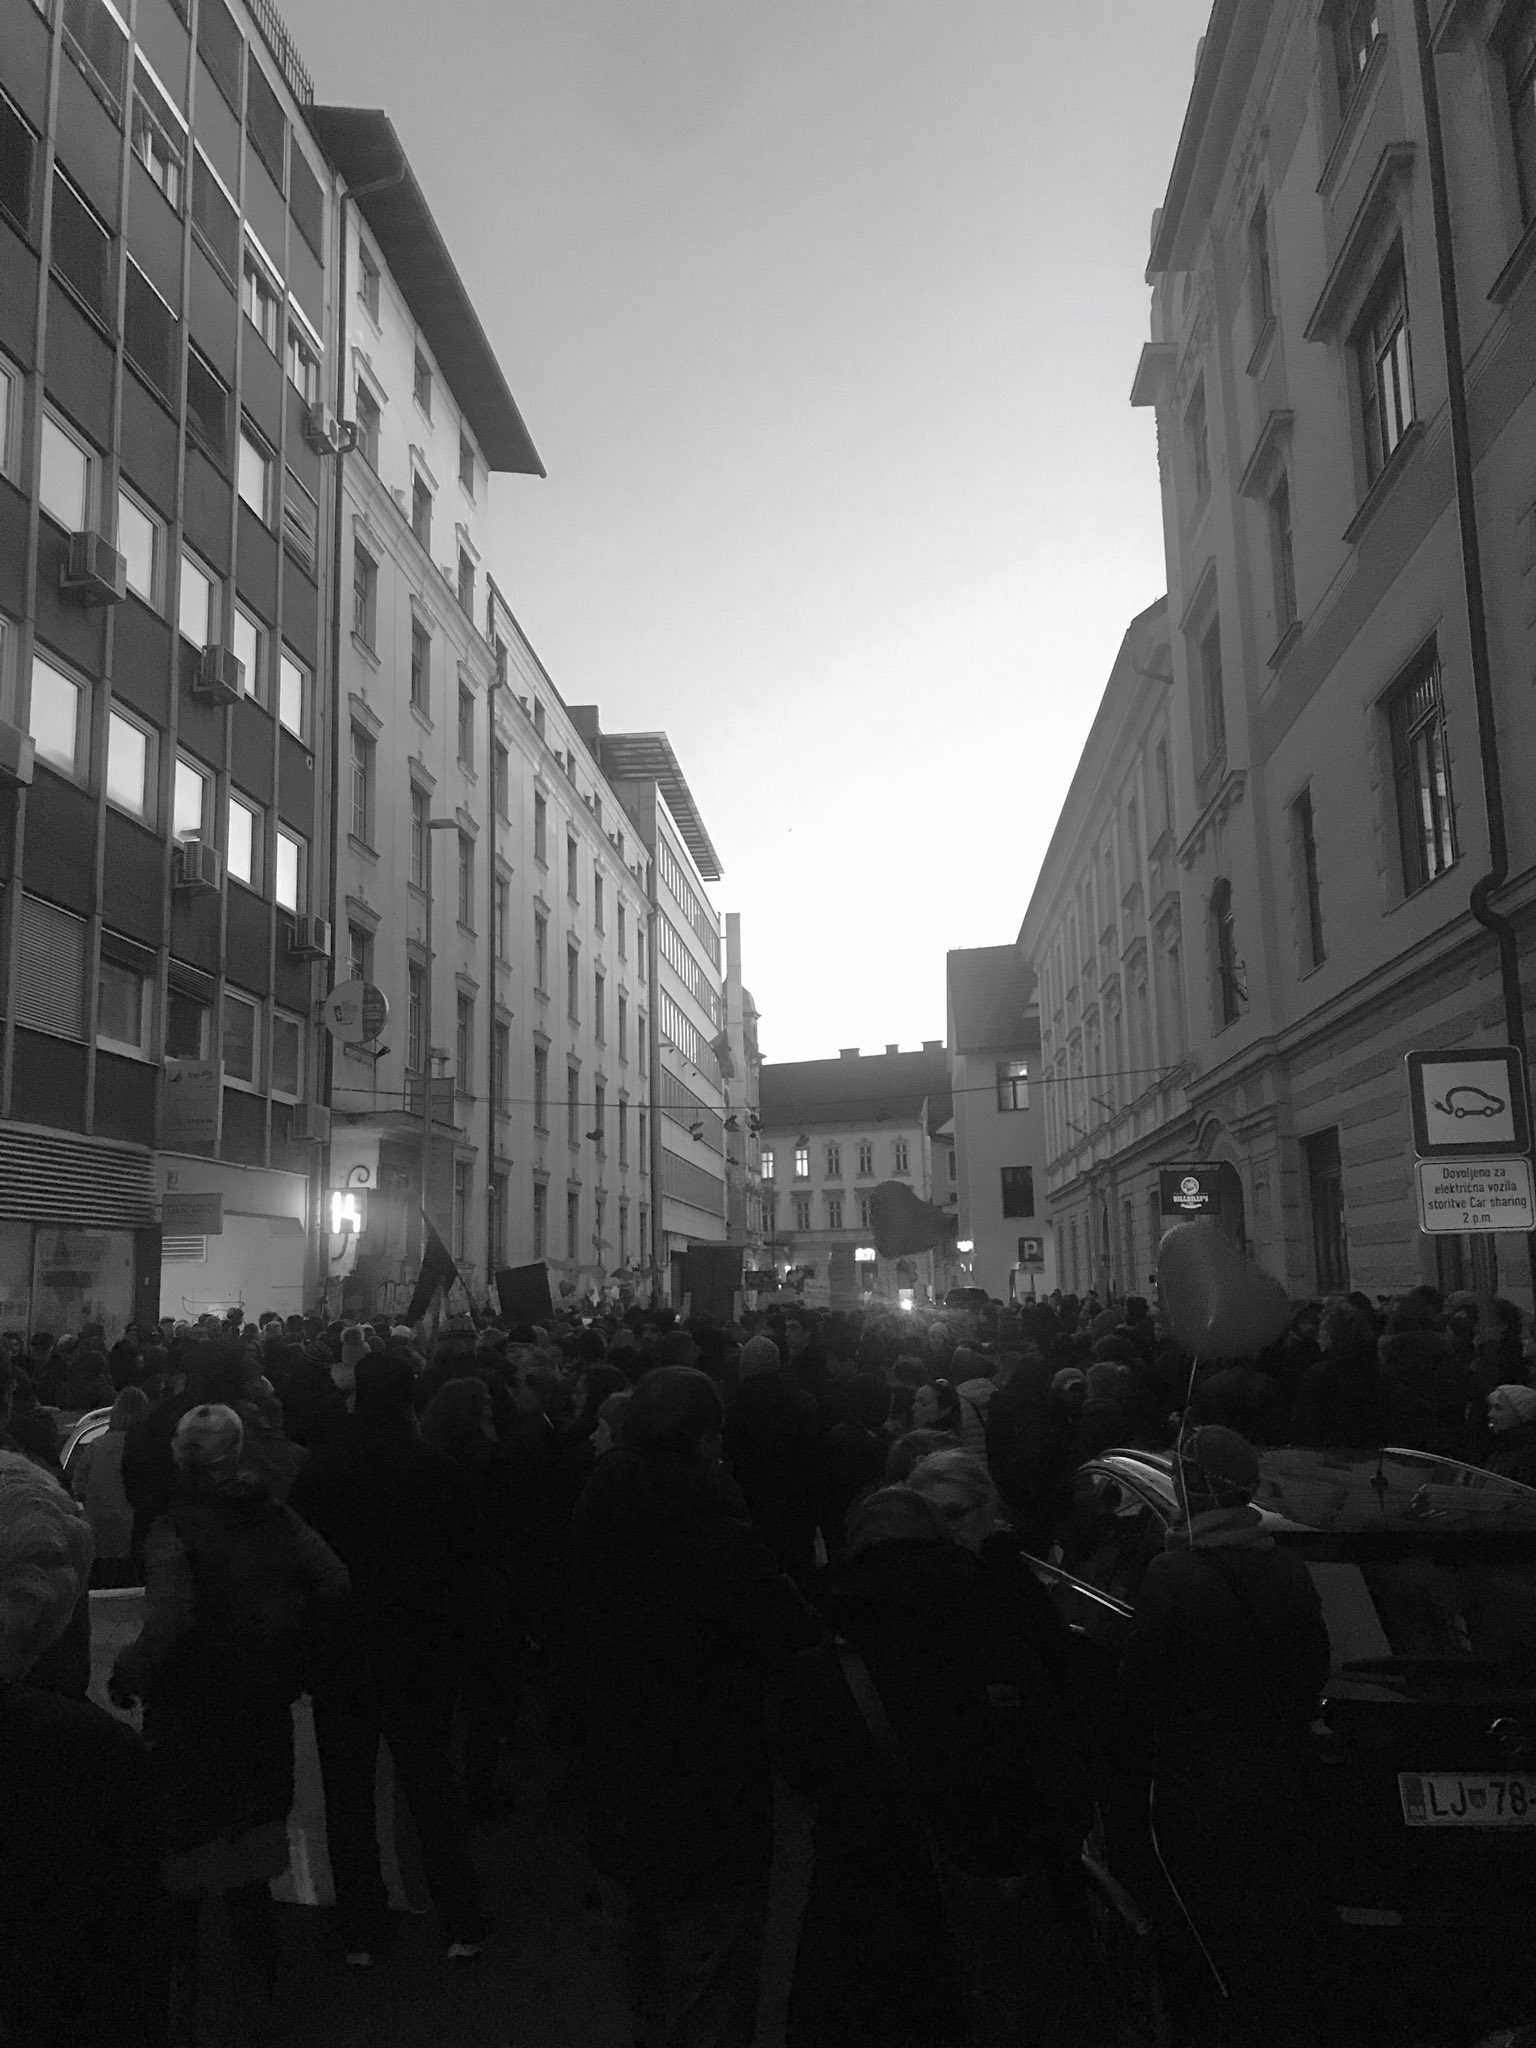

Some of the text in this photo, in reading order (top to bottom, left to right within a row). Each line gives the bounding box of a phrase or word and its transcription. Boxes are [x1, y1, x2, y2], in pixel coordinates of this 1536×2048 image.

[1443, 1168, 1506, 1180] Dovoljeno za
[1487, 1181, 1517, 1192] vozila
[1428, 1196, 1527, 1210] storitve Car sharing
[1463, 1212, 1469, 1223] 2
[1024, 1240, 1038, 1259] P
